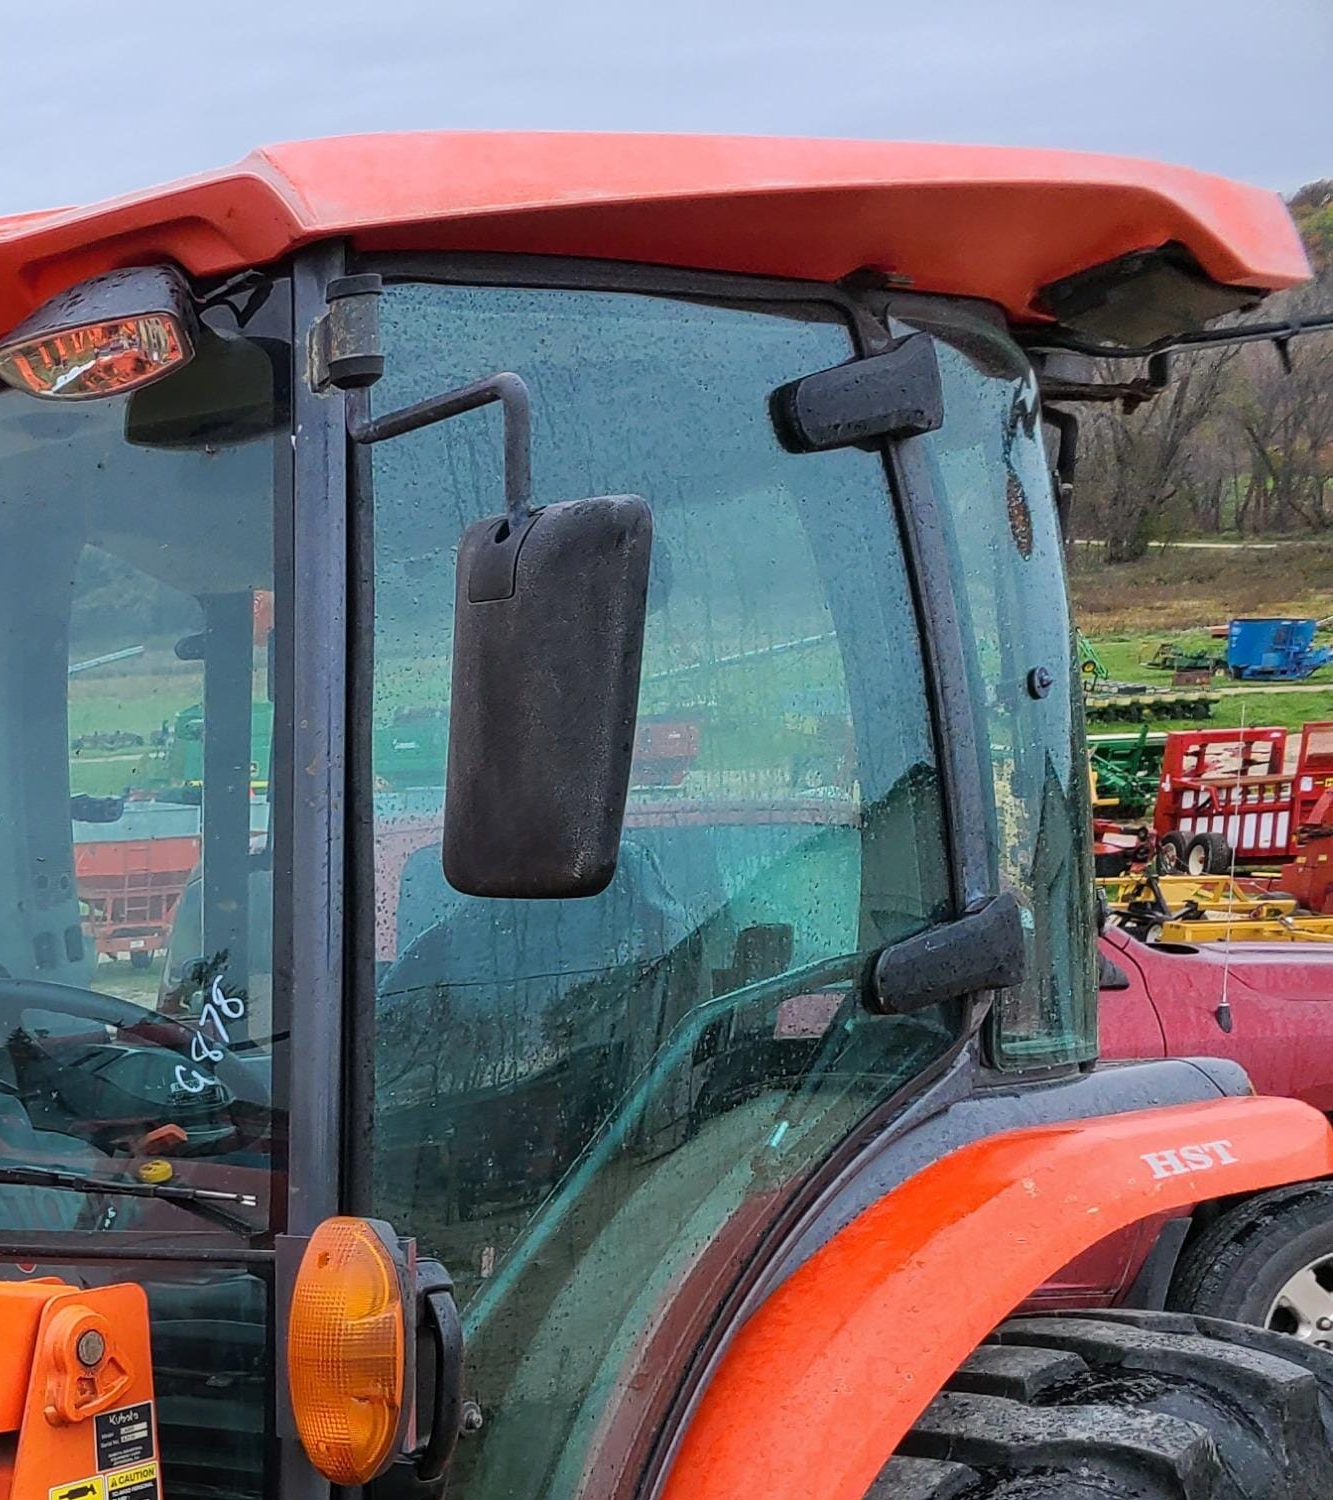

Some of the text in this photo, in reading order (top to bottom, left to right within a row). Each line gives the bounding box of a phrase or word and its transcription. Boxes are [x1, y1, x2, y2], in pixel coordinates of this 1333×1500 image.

[1140, 1139, 1239, 1180] HST
[109, 1411, 139, 1425] Kubota
[118, 1467, 155, 1486] CAUTION
